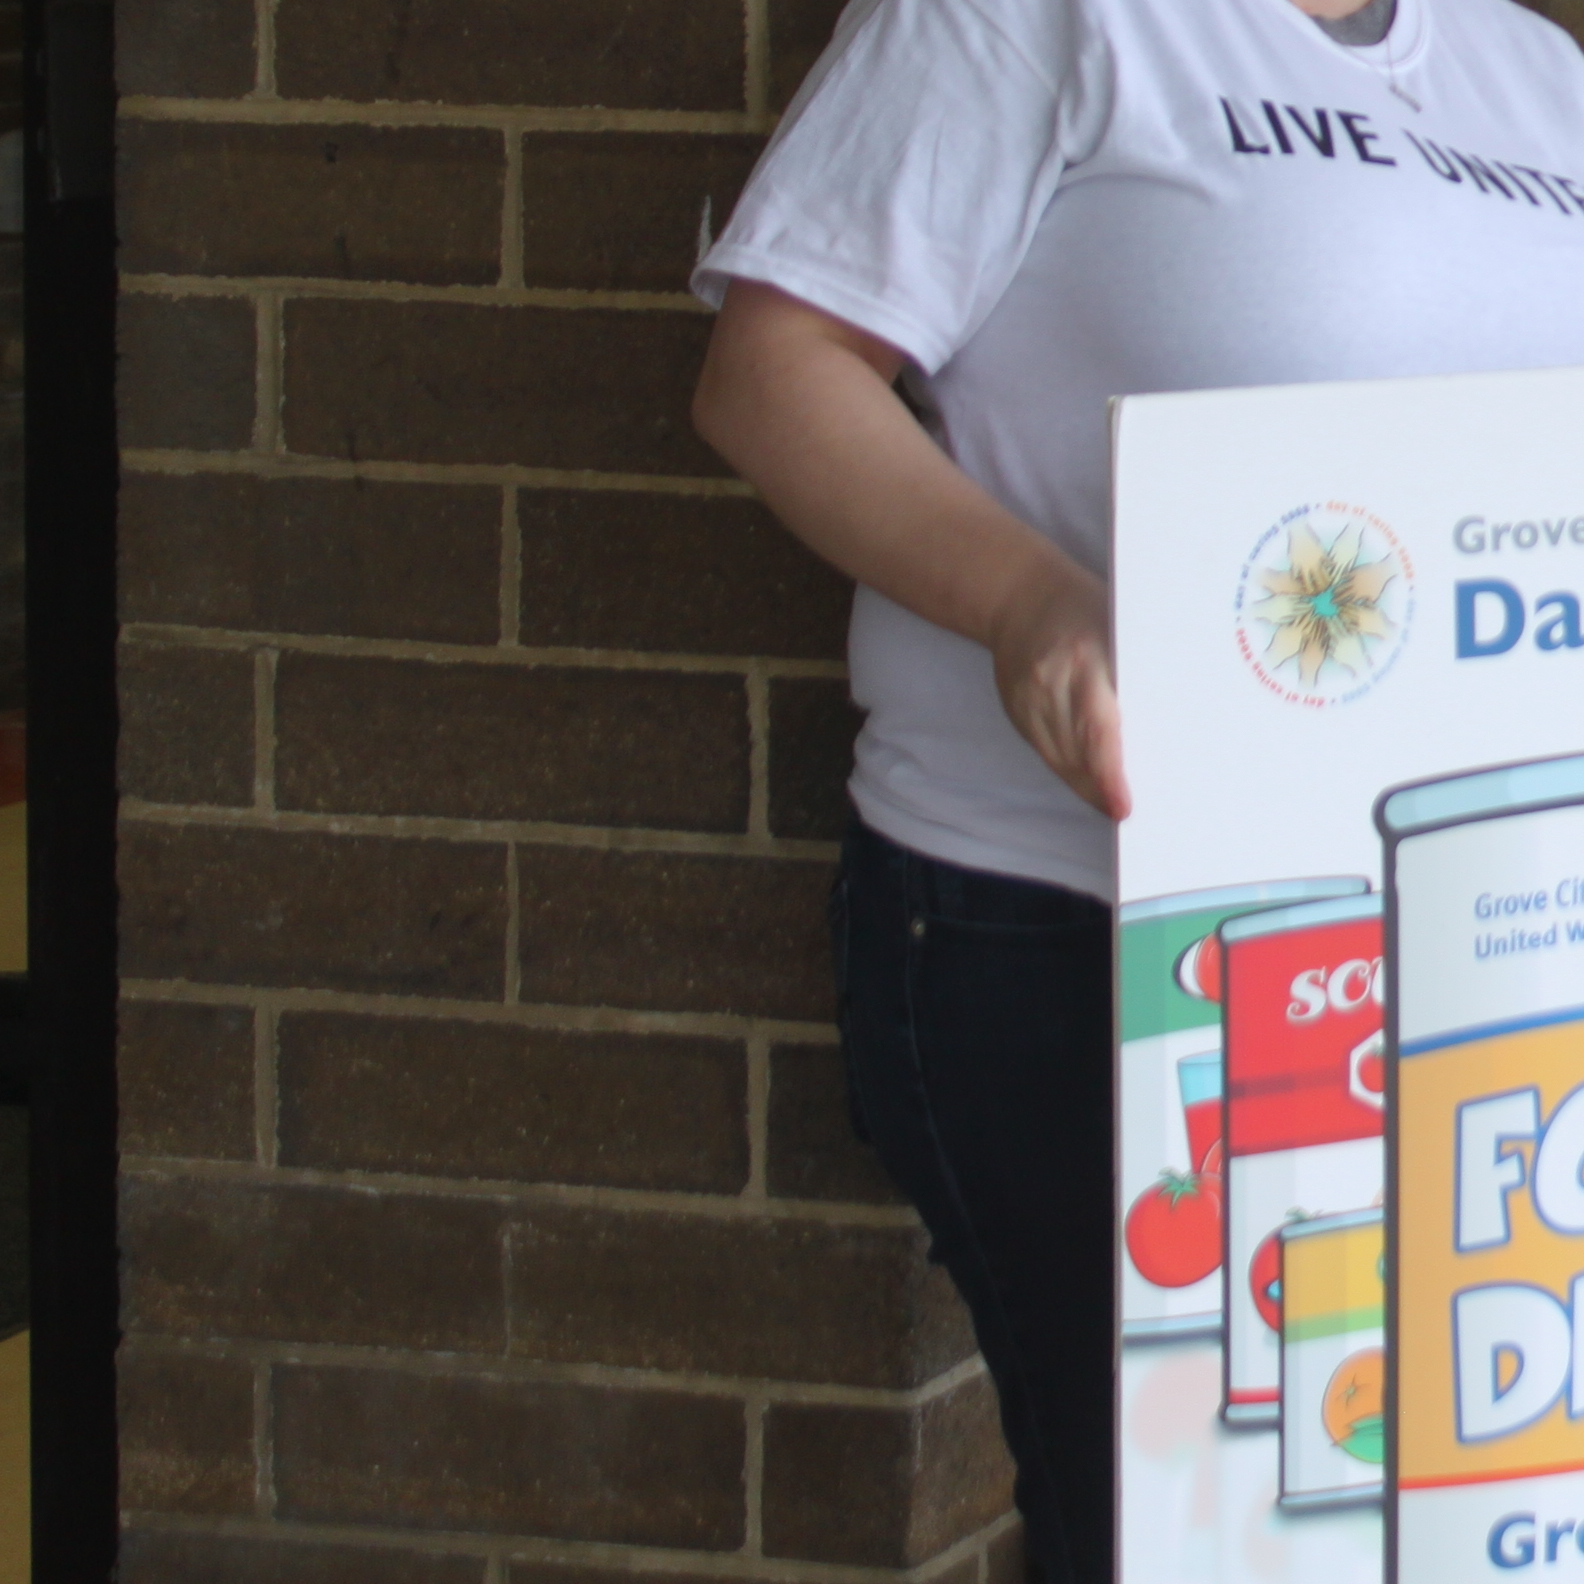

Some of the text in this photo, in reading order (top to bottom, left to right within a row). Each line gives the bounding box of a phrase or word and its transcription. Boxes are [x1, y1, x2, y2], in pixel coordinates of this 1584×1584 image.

[1219, 95, 1398, 167] LIVE
[1474, 890, 1548, 922] Grove
[1475, 923, 1558, 959] United
